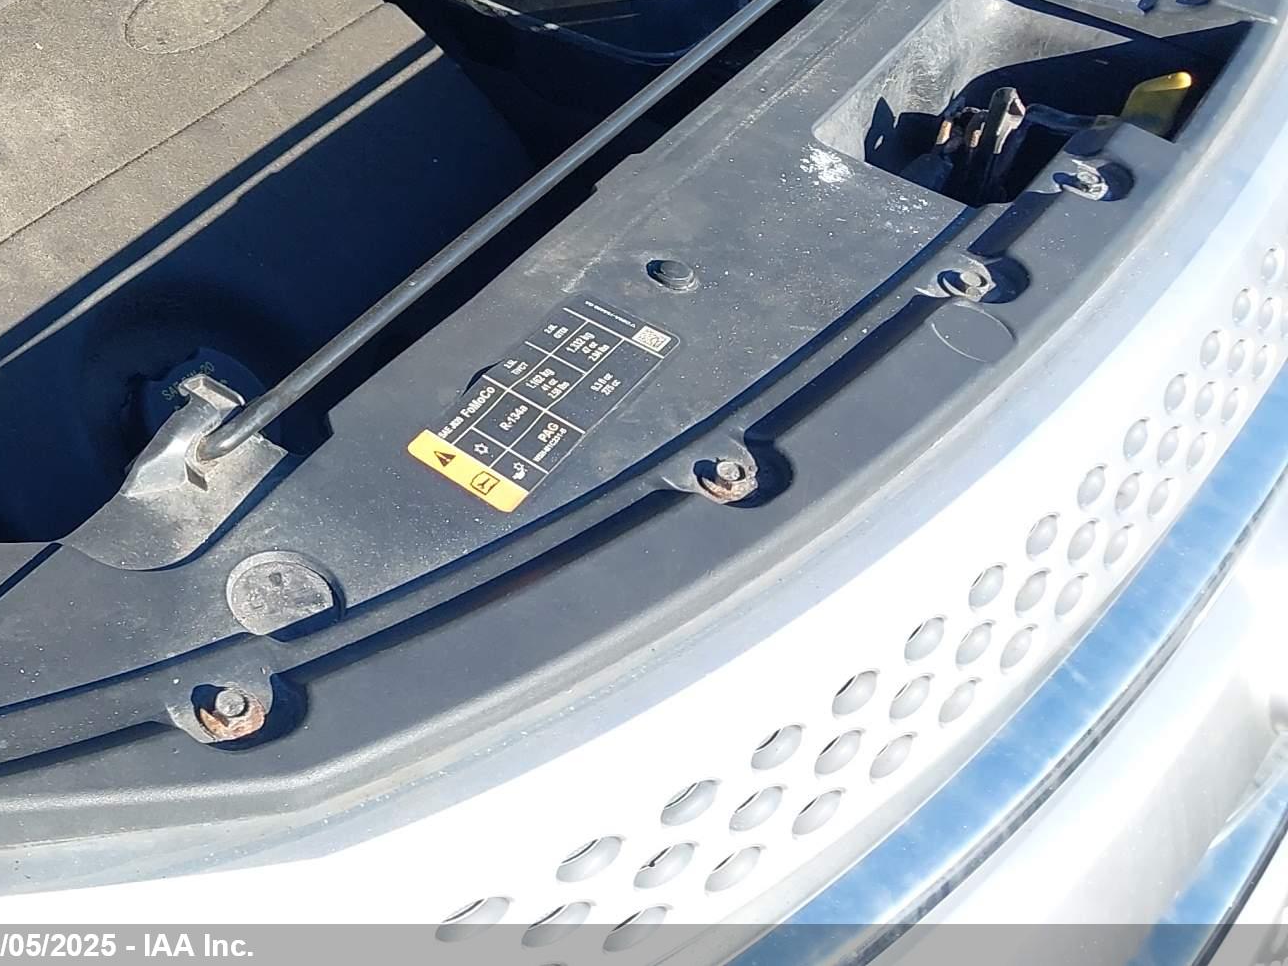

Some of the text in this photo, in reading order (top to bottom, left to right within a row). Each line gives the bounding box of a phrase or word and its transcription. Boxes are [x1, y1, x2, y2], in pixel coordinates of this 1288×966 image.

[579, 332, 595, 341] kg
[539, 368, 555, 378] kg
[460, 386, 496, 418] FoMoCo
[499, 405, 529, 431] R-134a
[537, 422, 560, 442] PAG
